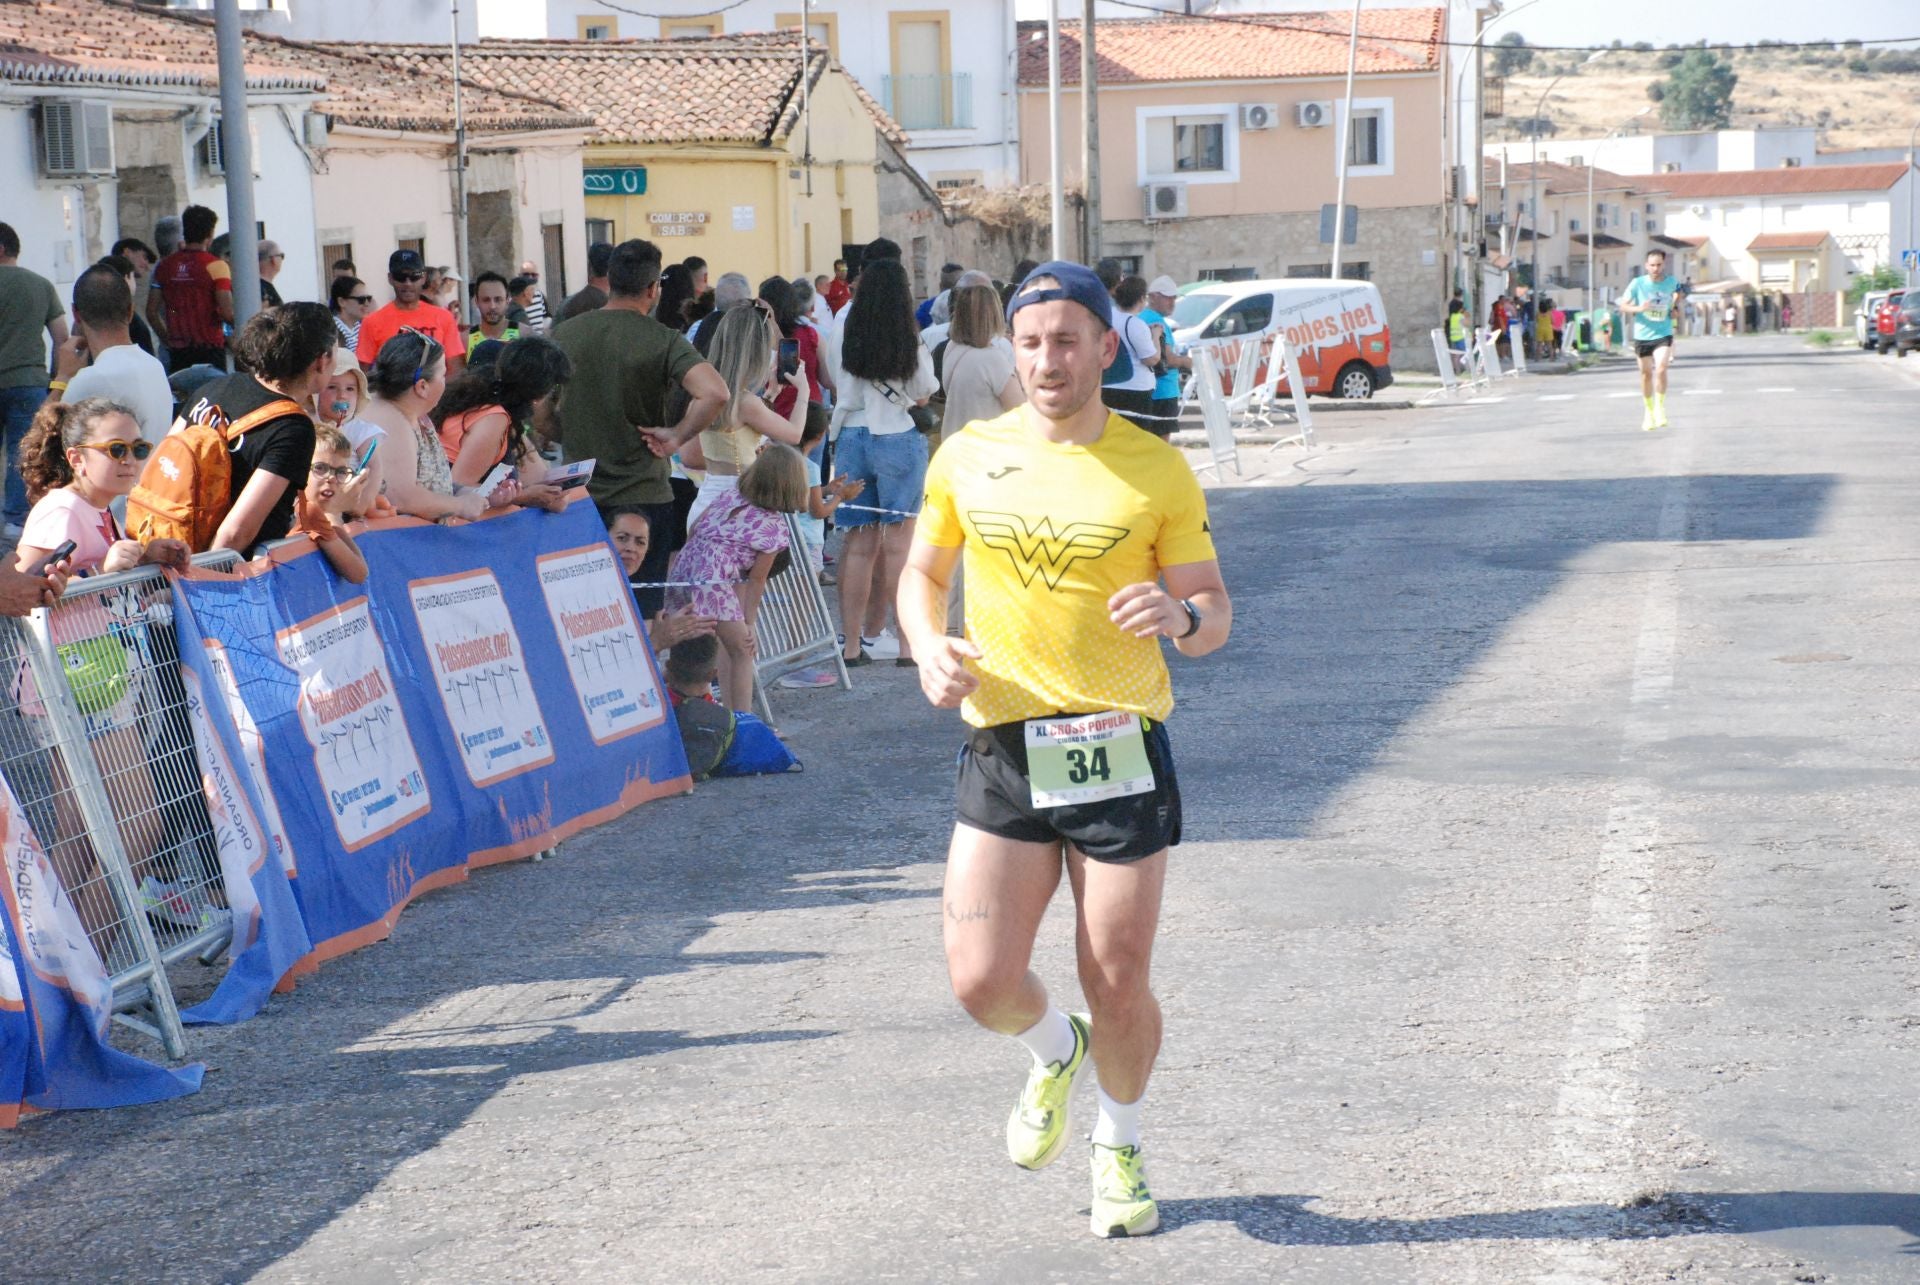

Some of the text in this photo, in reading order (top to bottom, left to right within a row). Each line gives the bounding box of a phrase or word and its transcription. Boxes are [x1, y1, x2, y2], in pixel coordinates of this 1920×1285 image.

[434, 629, 513, 674] Pulsaciones.net
[1036, 713, 1132, 737] XL CROSS POPULAR
[1066, 746, 1111, 783] 34
